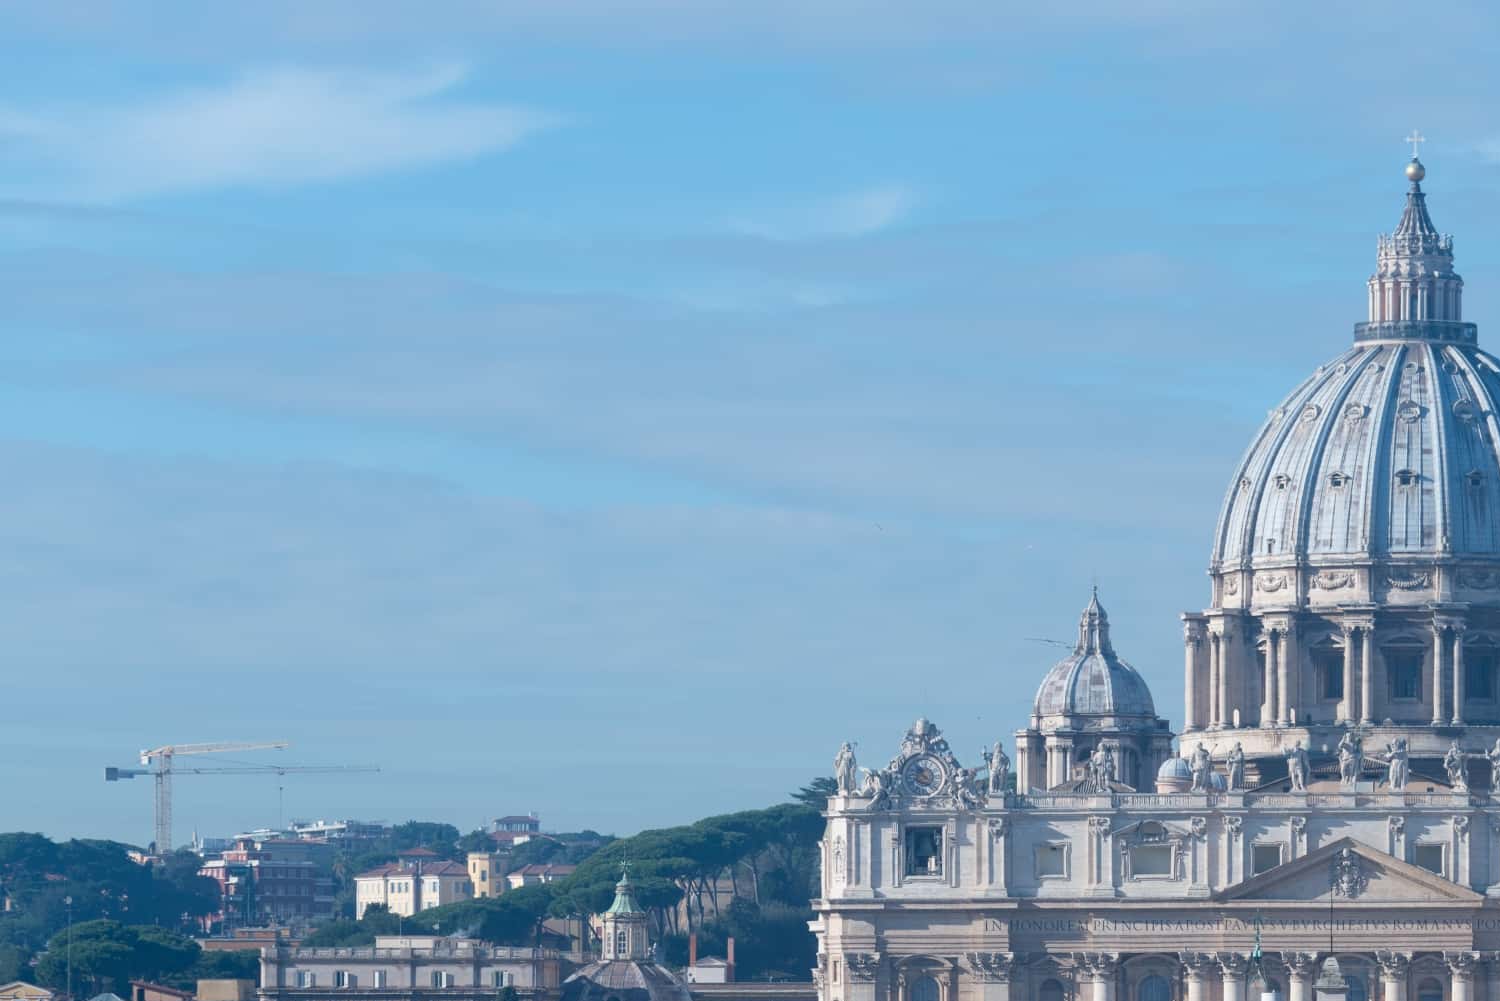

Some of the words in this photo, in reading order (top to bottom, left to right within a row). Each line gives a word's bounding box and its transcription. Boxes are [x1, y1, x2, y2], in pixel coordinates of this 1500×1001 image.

[985, 919, 1001, 931] IN
[1010, 919, 1089, 931] HONOREM
[1393, 919, 1471, 930] ROMANVS
